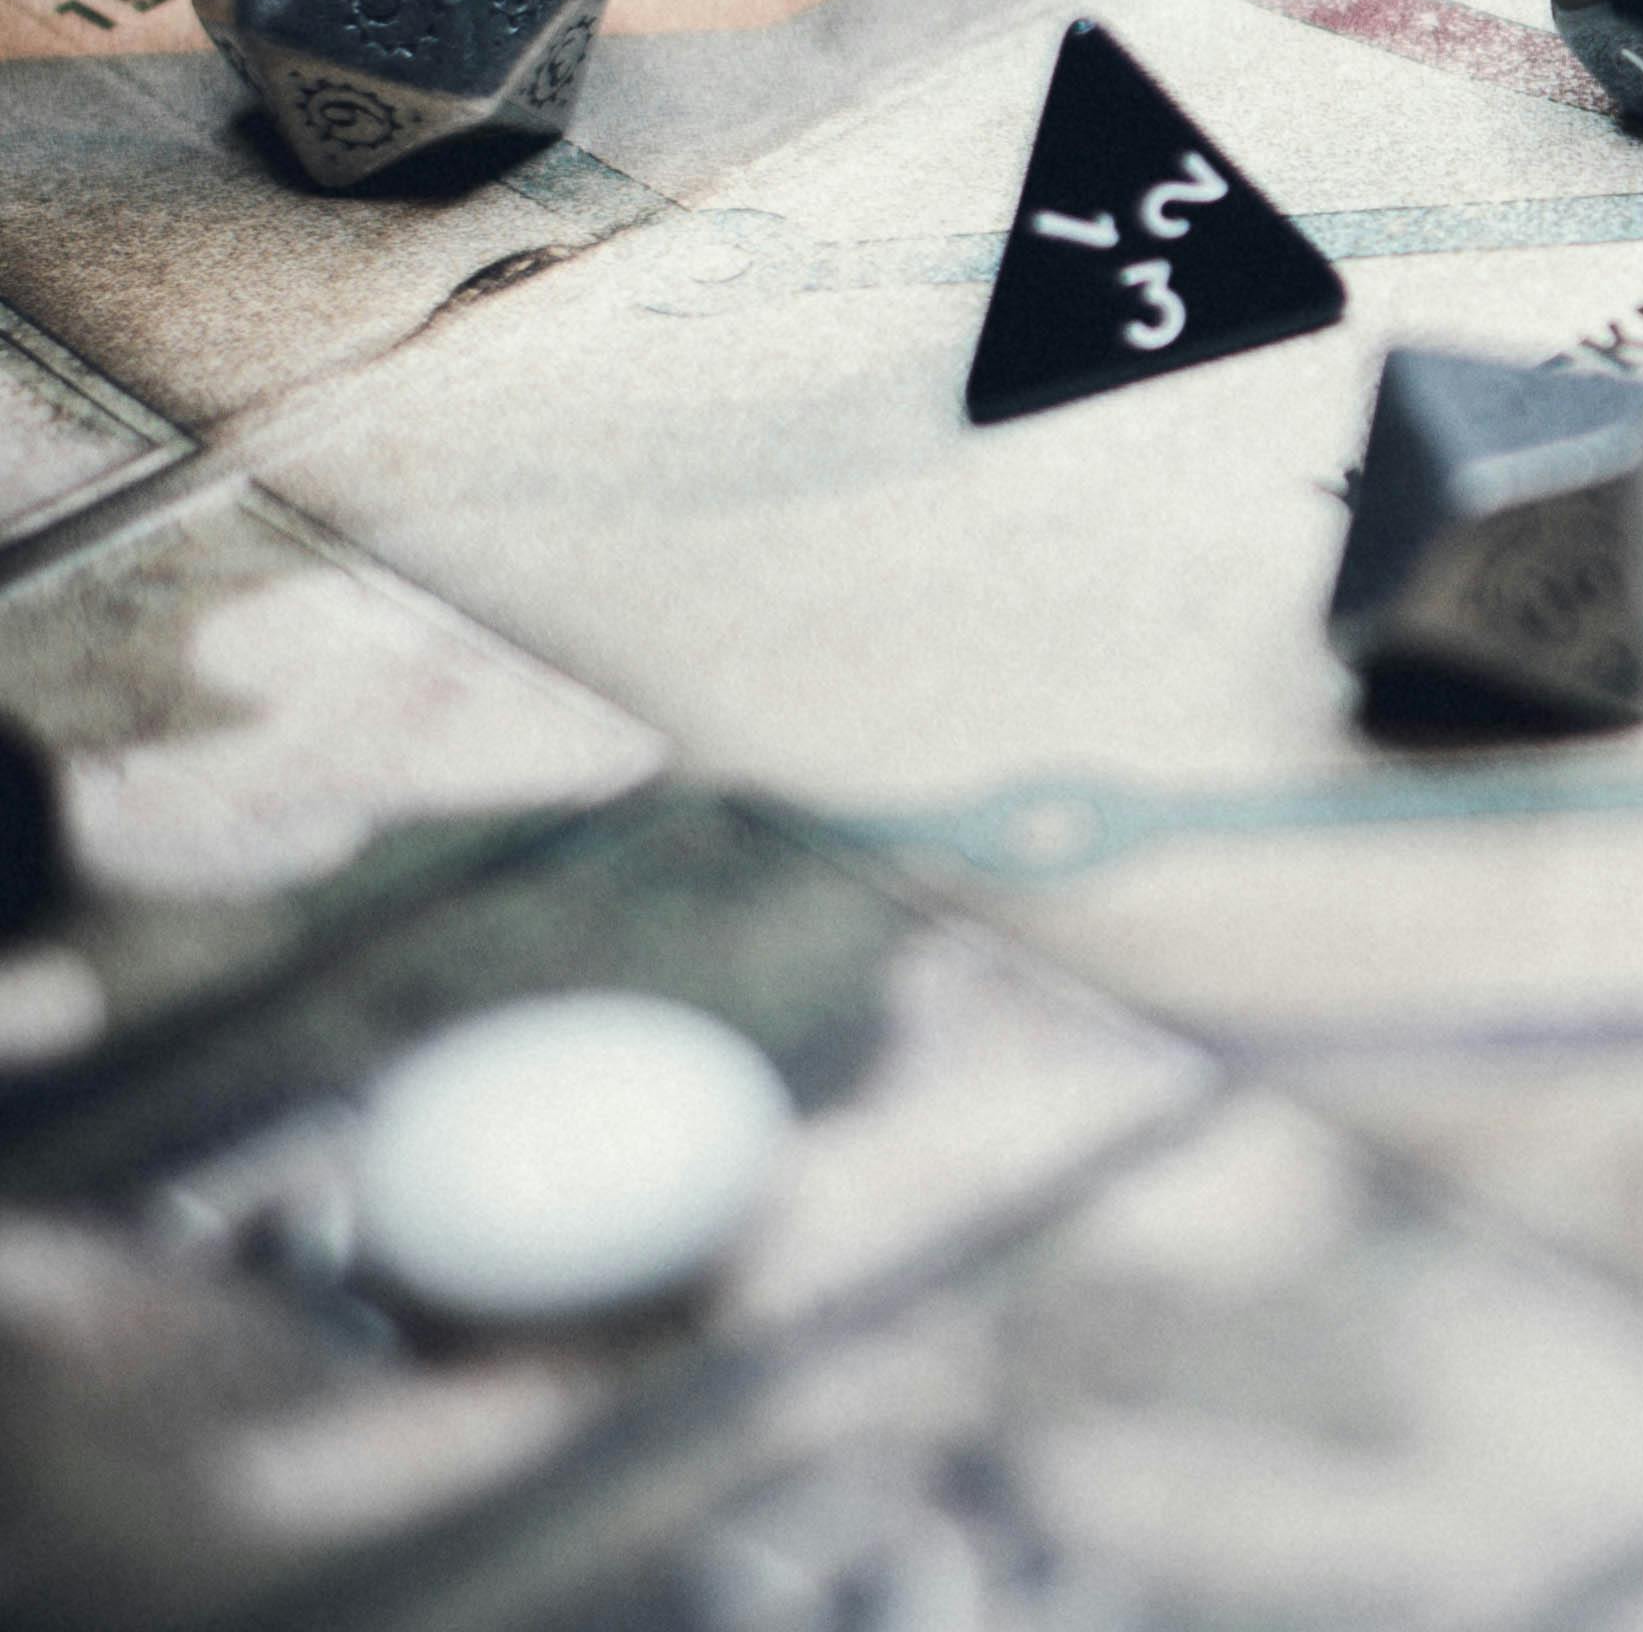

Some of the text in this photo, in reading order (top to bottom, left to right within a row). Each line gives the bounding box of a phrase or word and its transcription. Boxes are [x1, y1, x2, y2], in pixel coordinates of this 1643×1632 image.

[1031, 208, 1120, 251] 1
[1137, 151, 1230, 241] 2
[1118, 259, 1188, 352] 3
